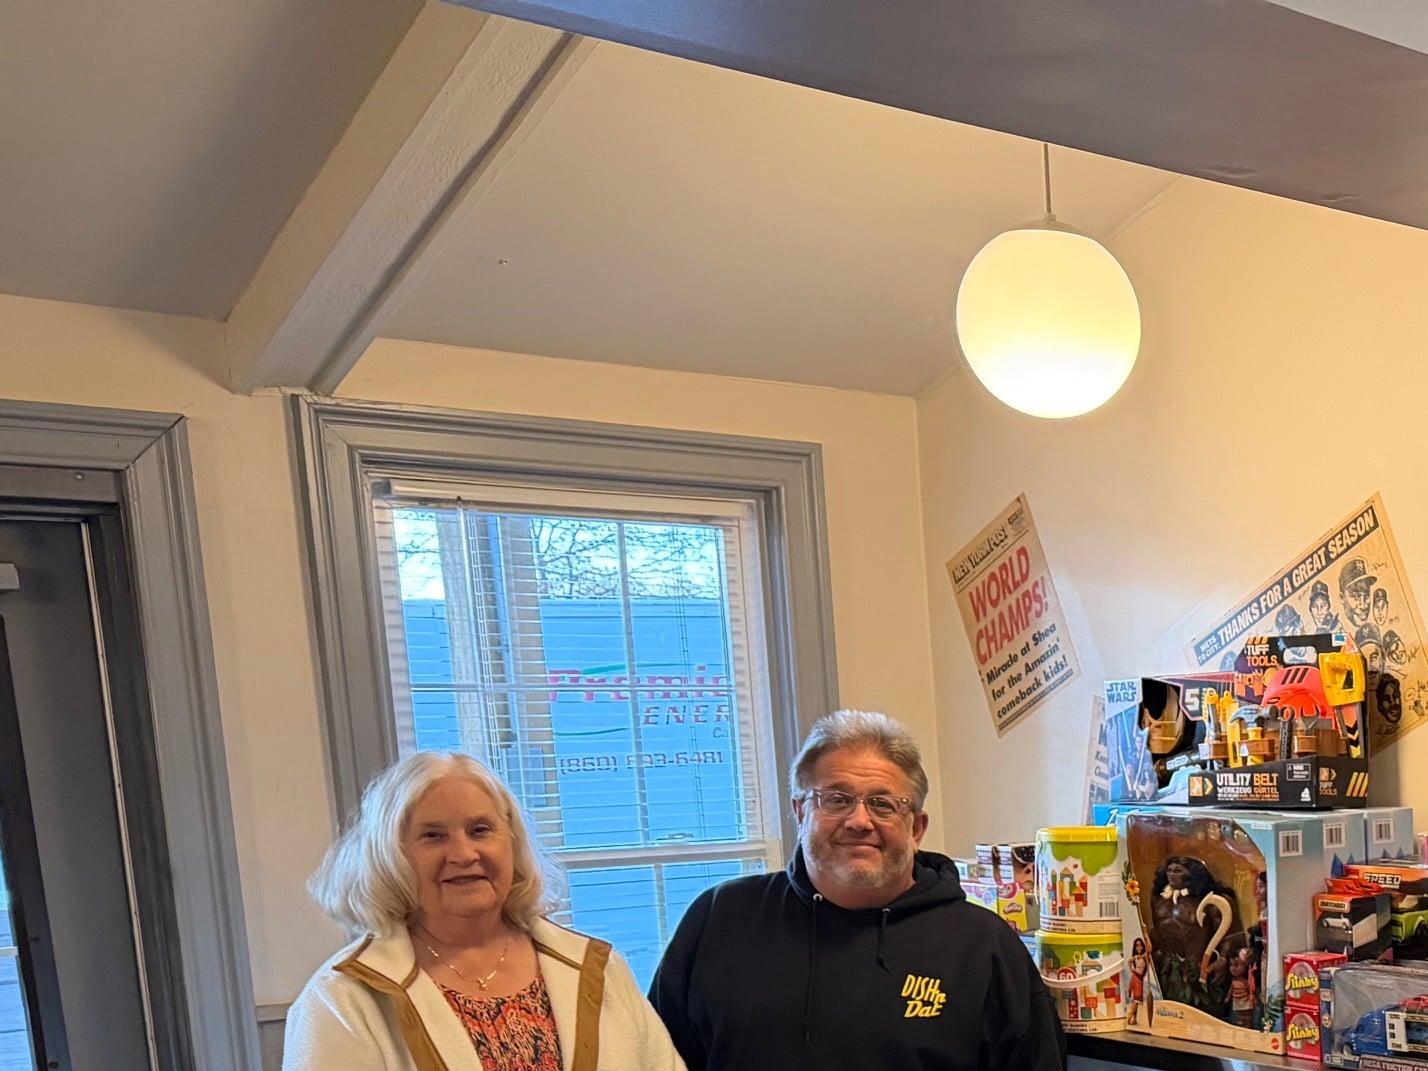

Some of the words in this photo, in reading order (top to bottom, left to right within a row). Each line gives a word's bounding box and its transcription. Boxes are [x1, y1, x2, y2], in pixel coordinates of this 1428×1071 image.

[969, 546, 1031, 623] WORLD
[1218, 603, 1260, 645] THANKS
[1260, 588, 1283, 614] FOR
[1283, 579, 1293, 597] A
[1292, 547, 1328, 589] GREAT
[1328, 508, 1375, 559] SEASON
[976, 575, 1049, 666] CHAMPS!
[987, 653, 1018, 685] Miracle
[1021, 641, 1031, 658] at
[1032, 624, 1056, 646] Shea
[1247, 643, 1270, 655] TUFF
[1247, 654, 1278, 667] TOOLS
[992, 681, 1006, 701] for
[1007, 669, 1022, 688] the
[998, 678, 1042, 718] comeback
[1043, 655, 1068, 682] kids!
[1106, 682, 1137, 692] STAR
[1107, 691, 1137, 703] WARS
[1216, 773, 1251, 786] UTILITY
[1253, 773, 1279, 786] BELT
[1217, 786, 1252, 794] WERKZEUG
[1363, 873, 1401, 885] SPEED
[901, 974, 941, 1001] DISH
[1285, 973, 1319, 992] Slinky
[1286, 1024, 1319, 1042] Slinky
[1364, 1059, 1381, 1069] MEGA
